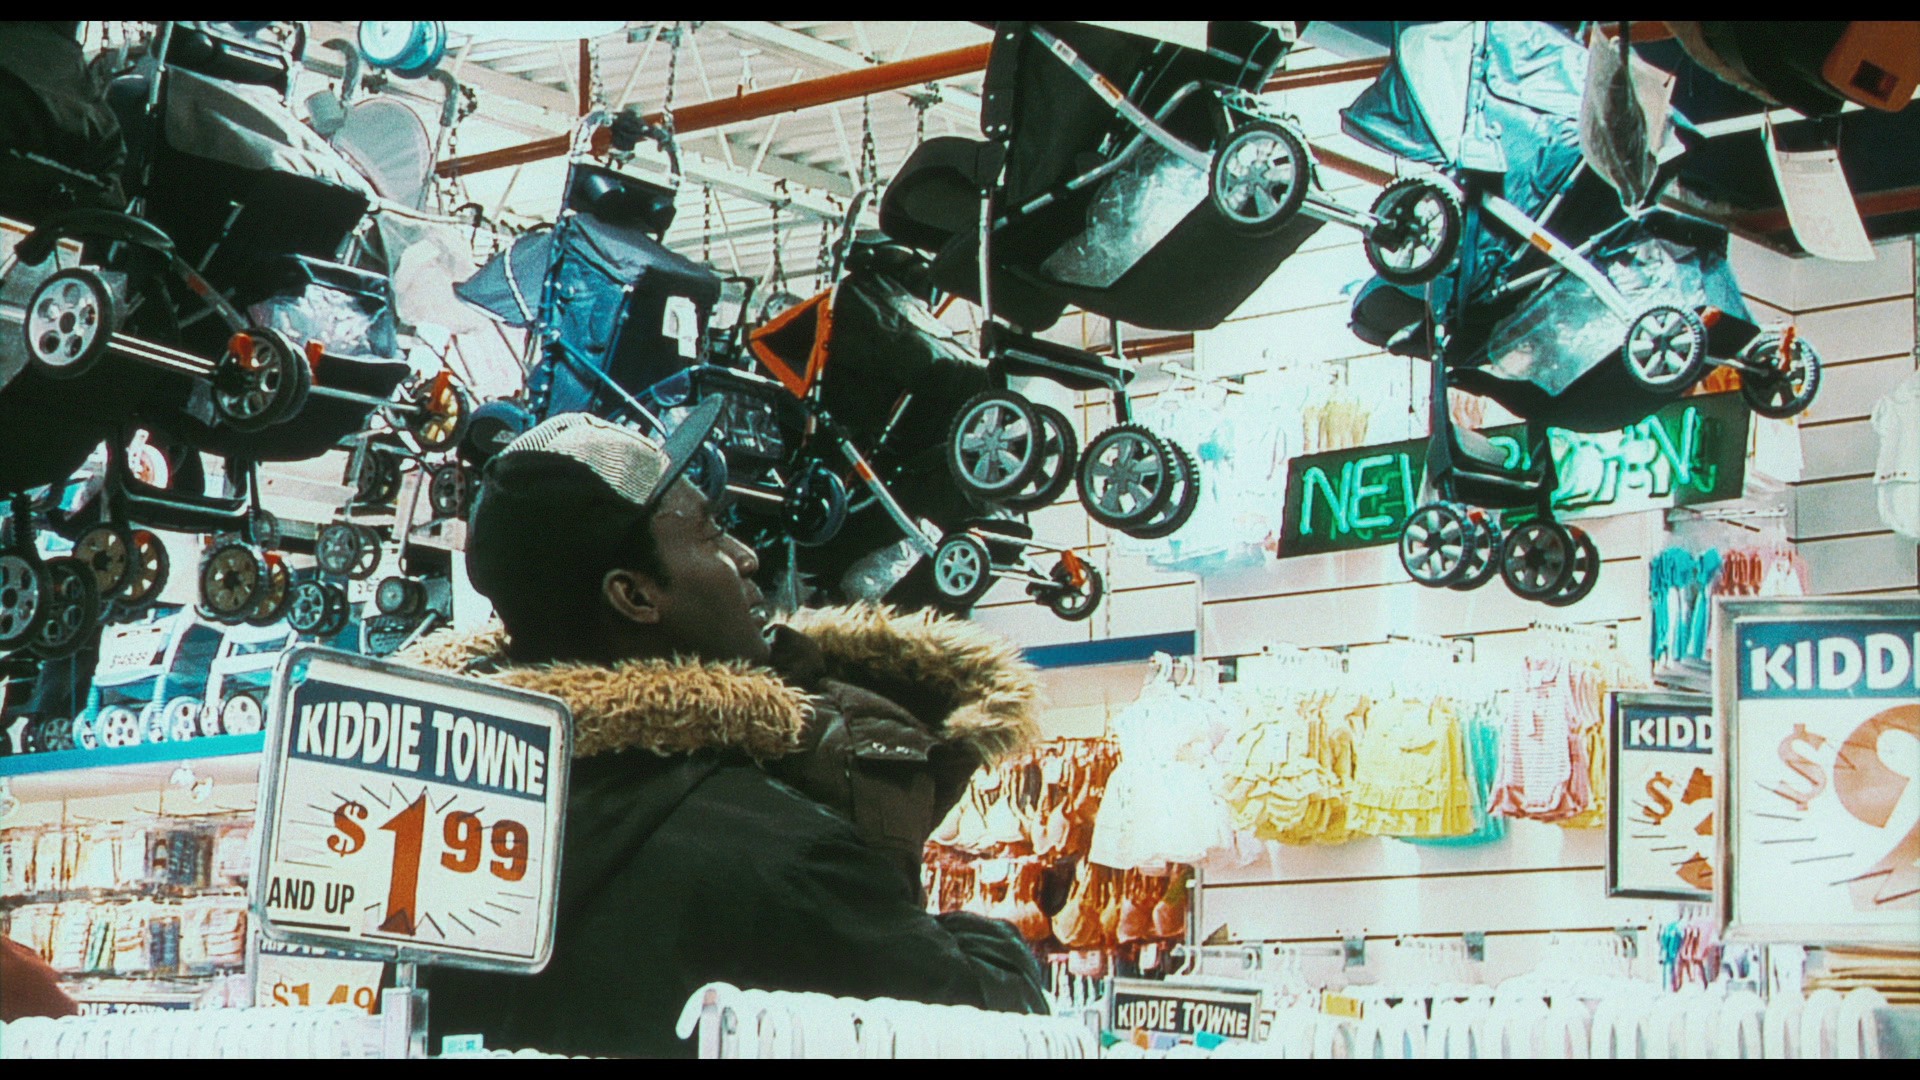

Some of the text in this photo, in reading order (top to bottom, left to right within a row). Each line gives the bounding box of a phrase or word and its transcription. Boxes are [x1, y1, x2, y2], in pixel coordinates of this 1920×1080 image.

[297, 701, 546, 796] KIDDIE TOWNE
[266, 876, 356, 915] AND UP
[1117, 1000, 1248, 1036] KIDDIE TOWNE
